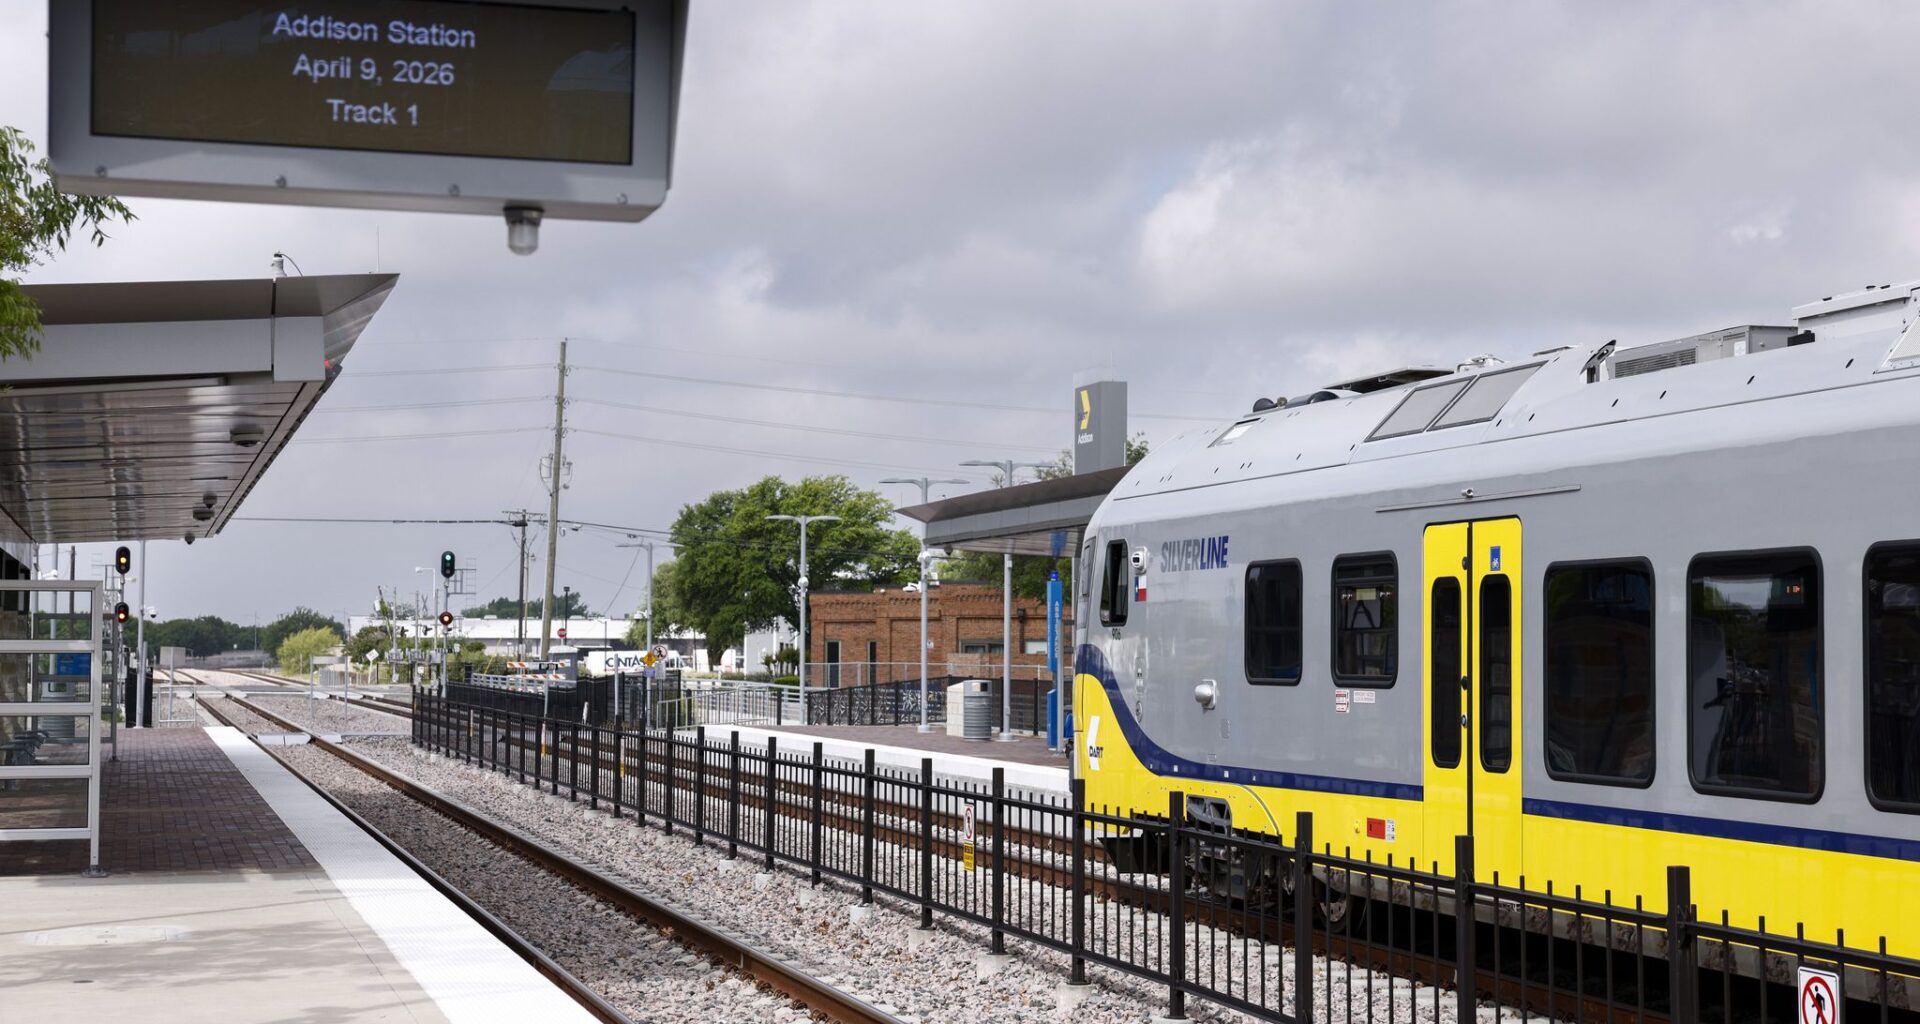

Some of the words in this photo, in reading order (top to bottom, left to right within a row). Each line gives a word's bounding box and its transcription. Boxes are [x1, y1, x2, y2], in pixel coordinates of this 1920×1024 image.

[272, 12, 378, 41] Addison
[387, 20, 475, 48] Station
[292, 53, 351, 83] April
[360, 57, 383, 86] 9,
[392, 60, 455, 86] 2026
[326, 98, 397, 125] Track
[407, 104, 418, 126] 1
[1160, 535, 1229, 574] SILVERLINE
[1112, 627, 1121, 641] 906
[605, 655, 646, 668] CNTA
[1089, 745, 1104, 758] DART
